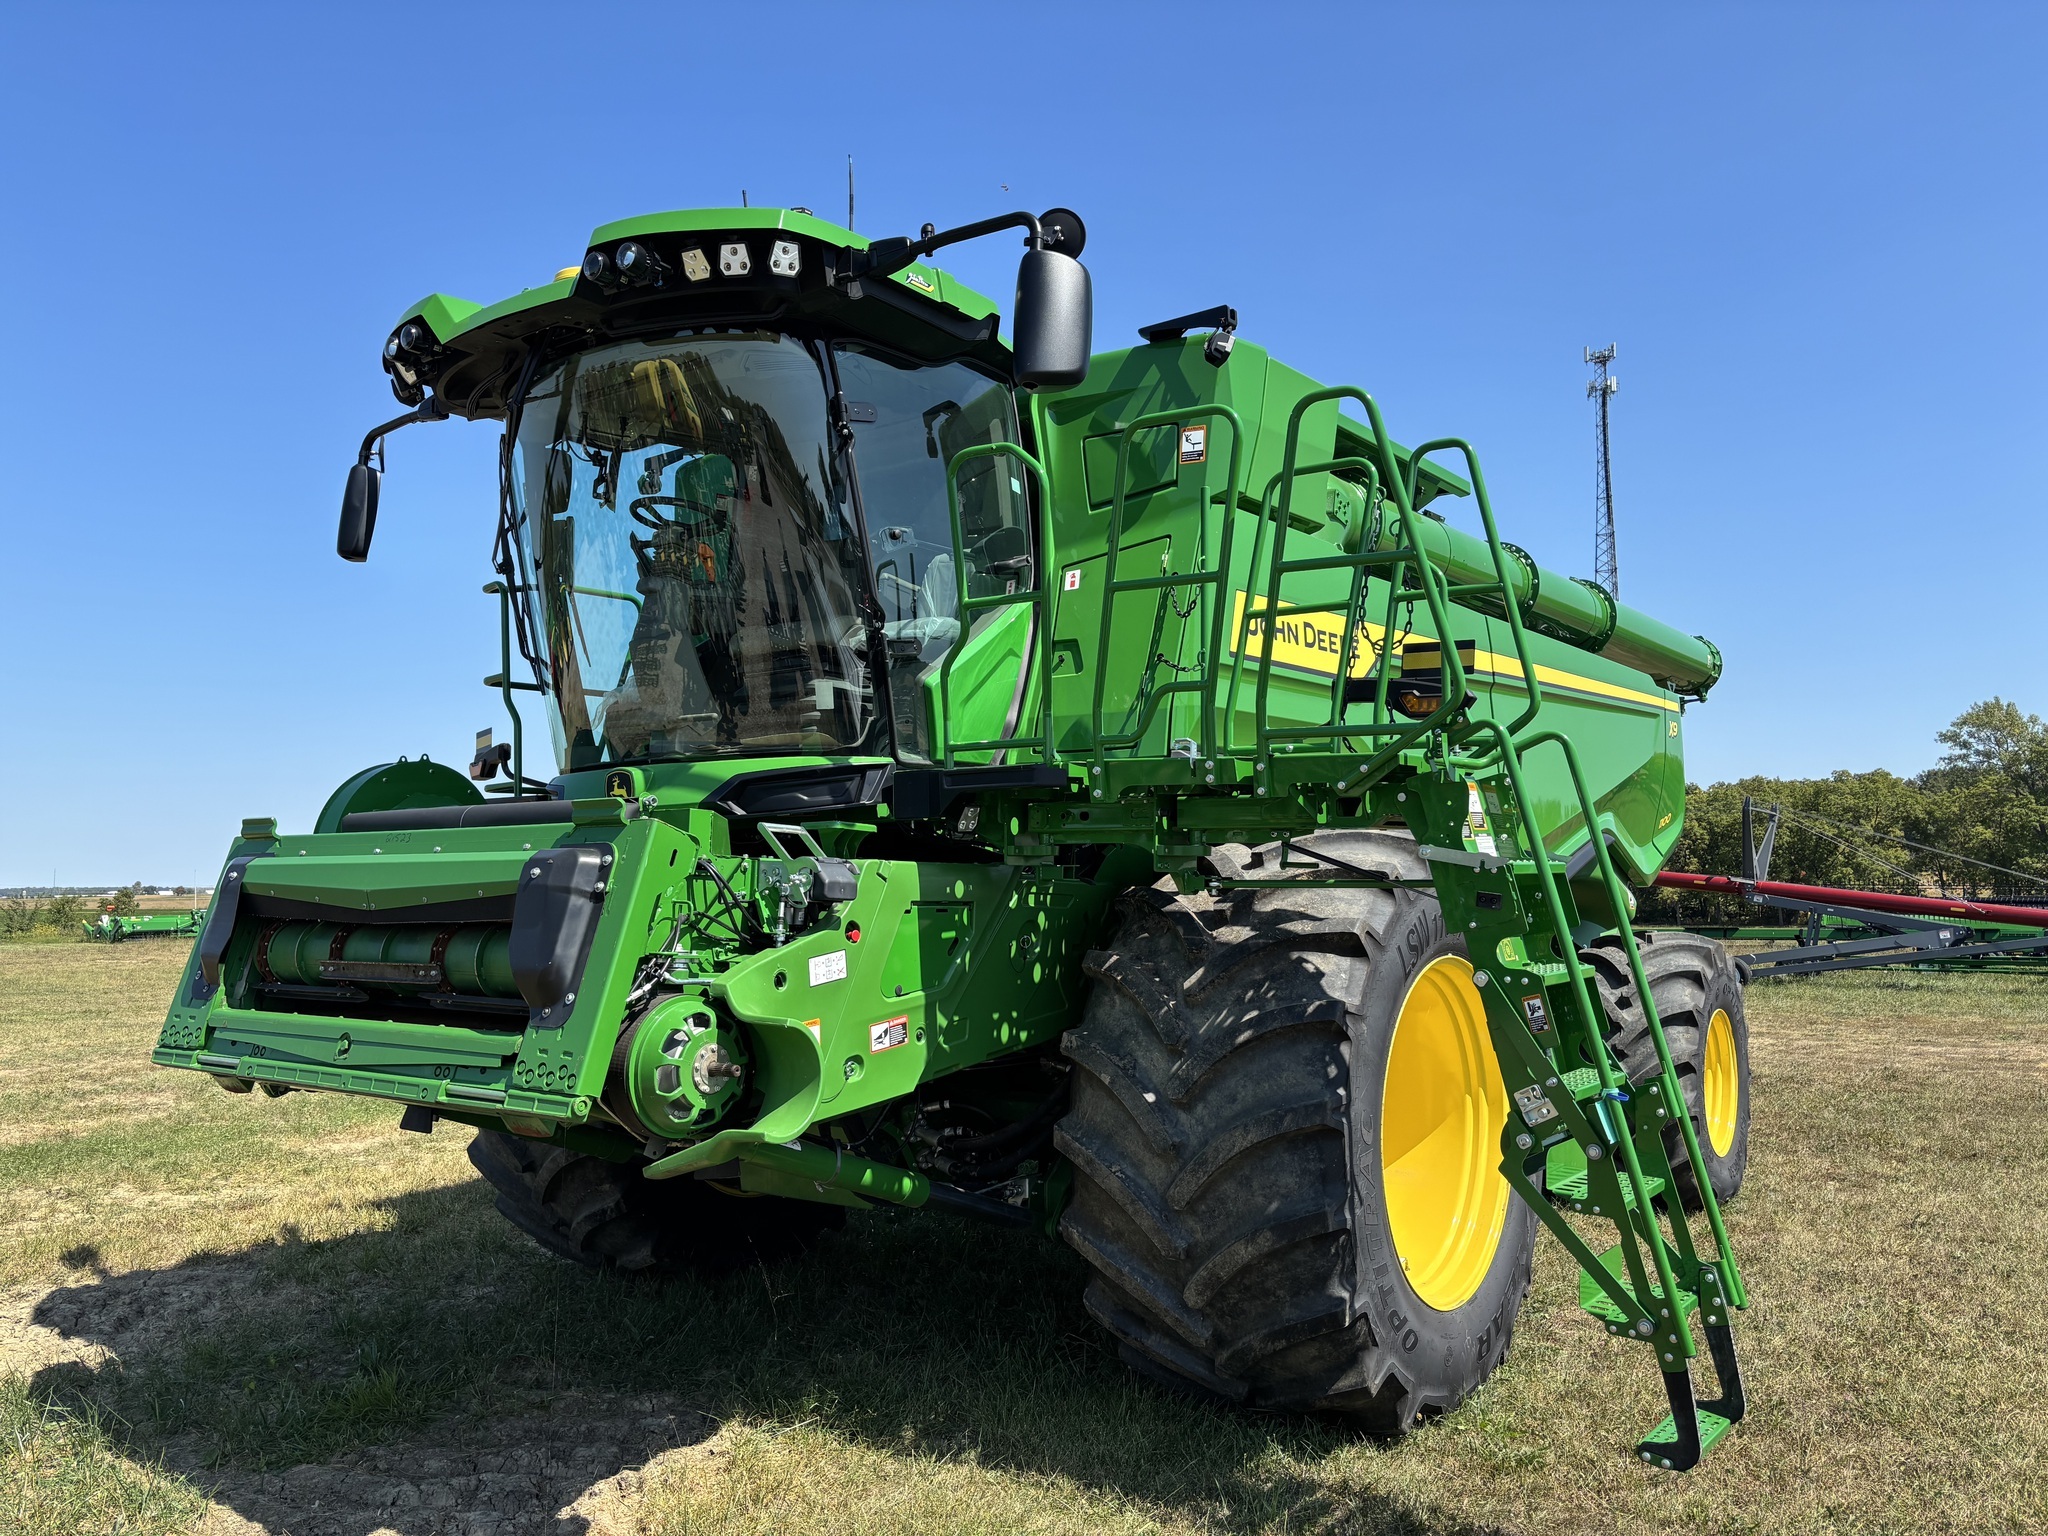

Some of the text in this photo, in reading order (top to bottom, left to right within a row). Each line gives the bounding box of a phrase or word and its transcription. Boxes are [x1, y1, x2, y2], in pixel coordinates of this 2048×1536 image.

[1303, 621, 1361, 660] DEEE
[1396, 908, 1430, 987] LSW
[1359, 1109, 1419, 1355] OPTITRAC
